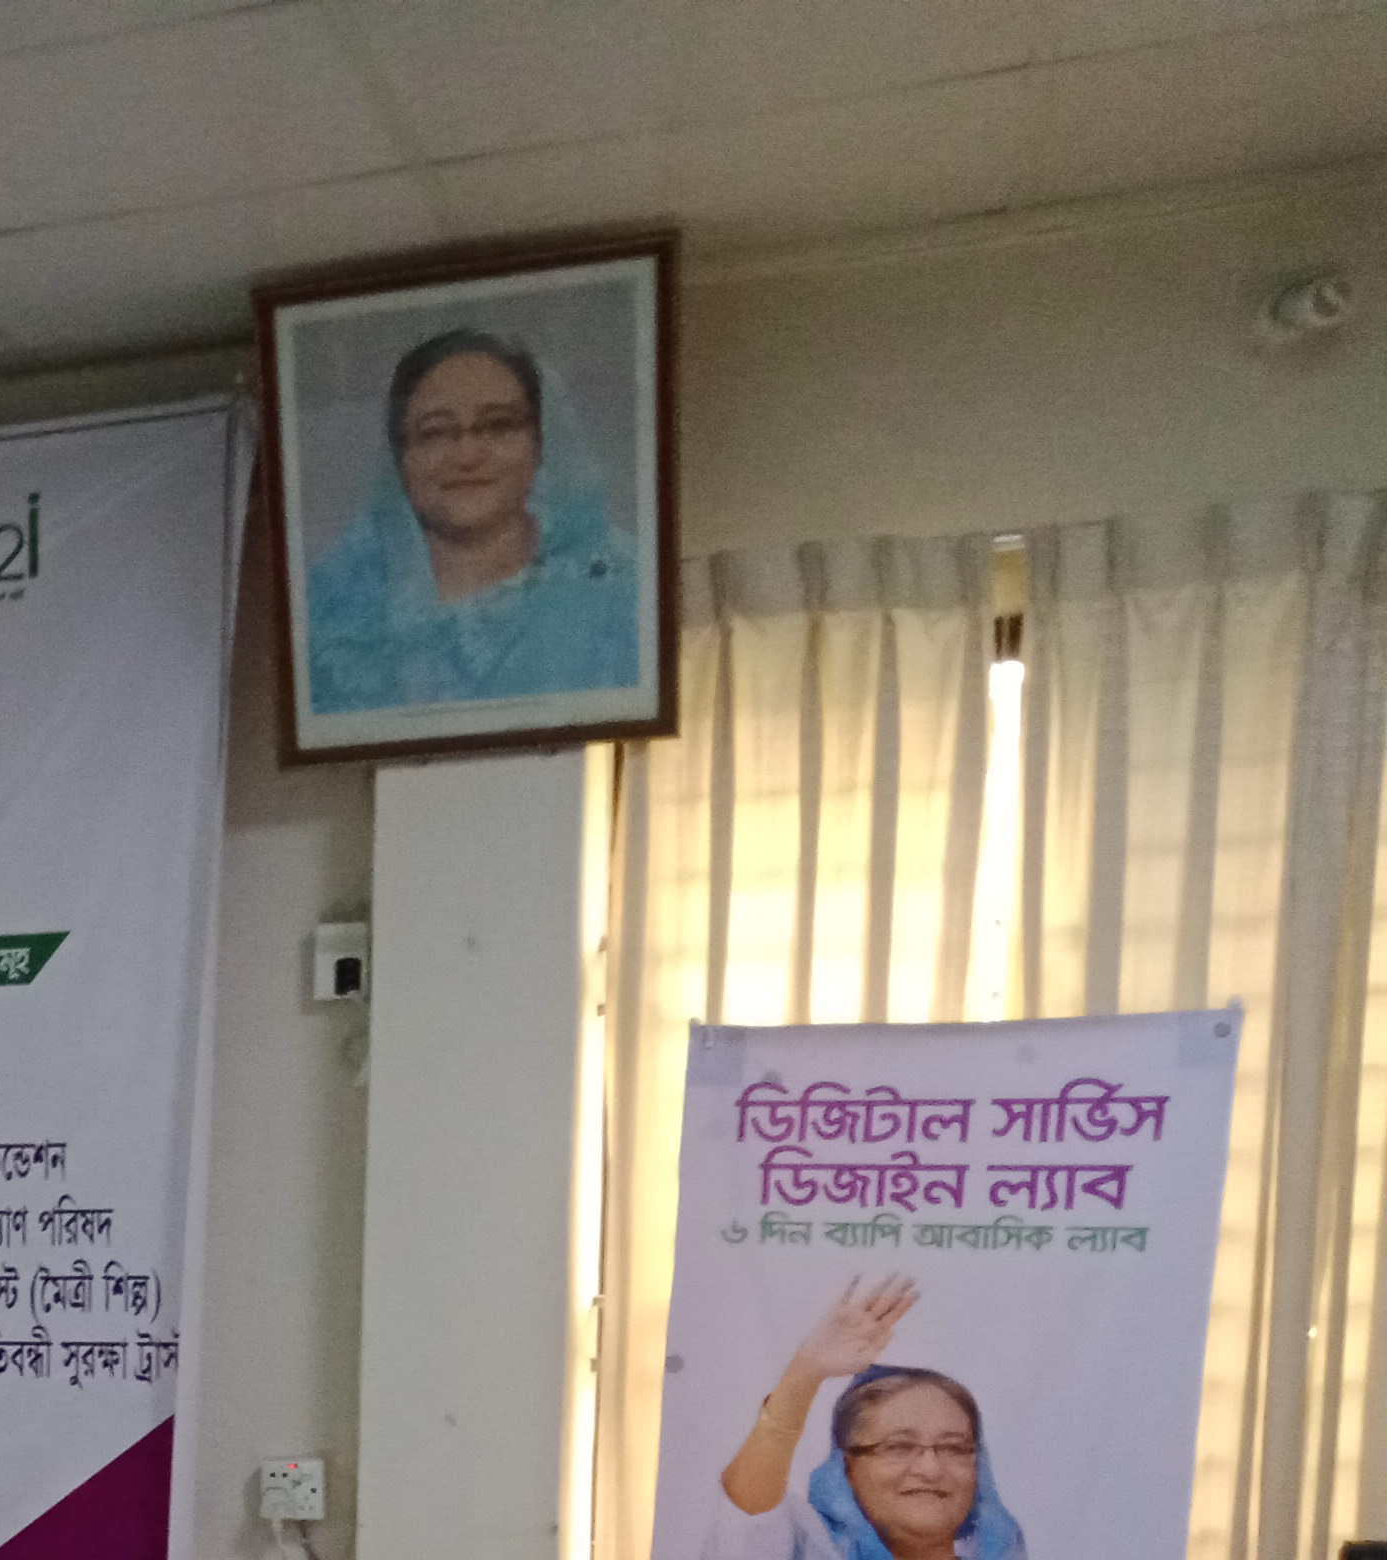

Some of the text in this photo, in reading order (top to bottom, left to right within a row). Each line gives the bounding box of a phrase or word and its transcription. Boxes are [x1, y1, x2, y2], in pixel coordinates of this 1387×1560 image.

[735, 1077, 1171, 1144] ডিজিটাল সার্ভিস
[759, 1145, 1133, 1213] ডিজাইন ল্যাব
[38, 1194, 115, 1249] পরিষদ
[720, 1220, 749, 1245] ৬
[759, 1210, 813, 1247] দিন
[912, 1215, 1054, 1251] আবাসিক
[1065, 1225, 1149, 1254] ল্যাব
[61, 1338, 129, 1388] সুরক্ষা
